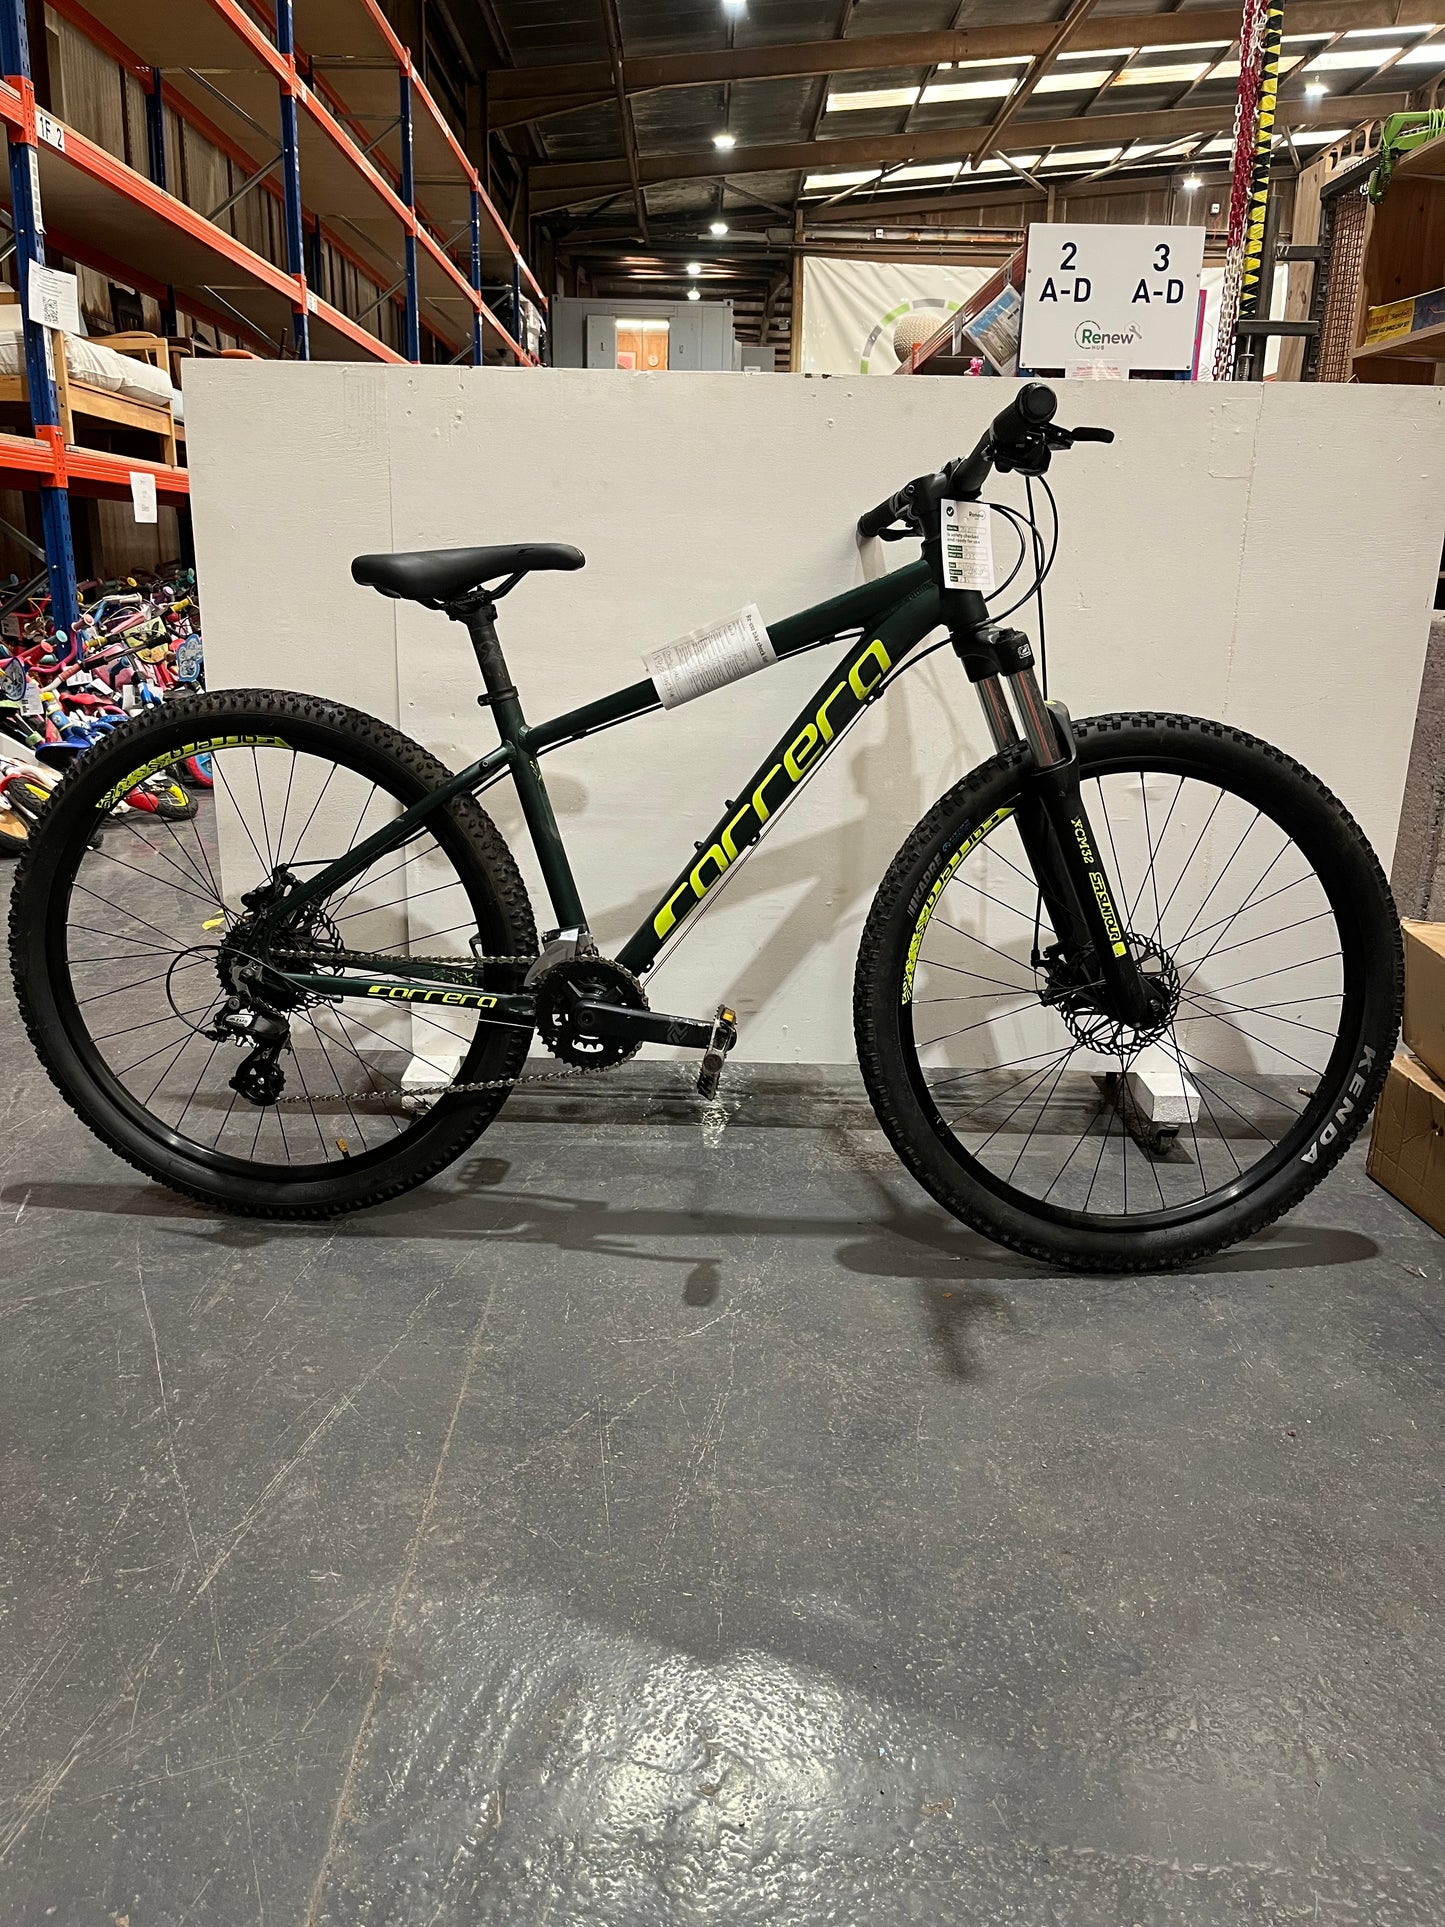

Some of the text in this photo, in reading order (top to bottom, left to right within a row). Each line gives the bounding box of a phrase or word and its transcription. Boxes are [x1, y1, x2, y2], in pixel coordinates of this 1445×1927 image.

[39, 116, 63, 148] 1F 2
[1060, 242, 1170, 272] 2 3
[1039, 277, 1184, 304] A-D A-D
[1081, 328, 1134, 345] Renew
[653, 639, 892, 943] carrera
[1071, 815, 1094, 864] XCM32
[367, 985, 498, 1008] carrera
[1301, 1044, 1376, 1164] KENDA
